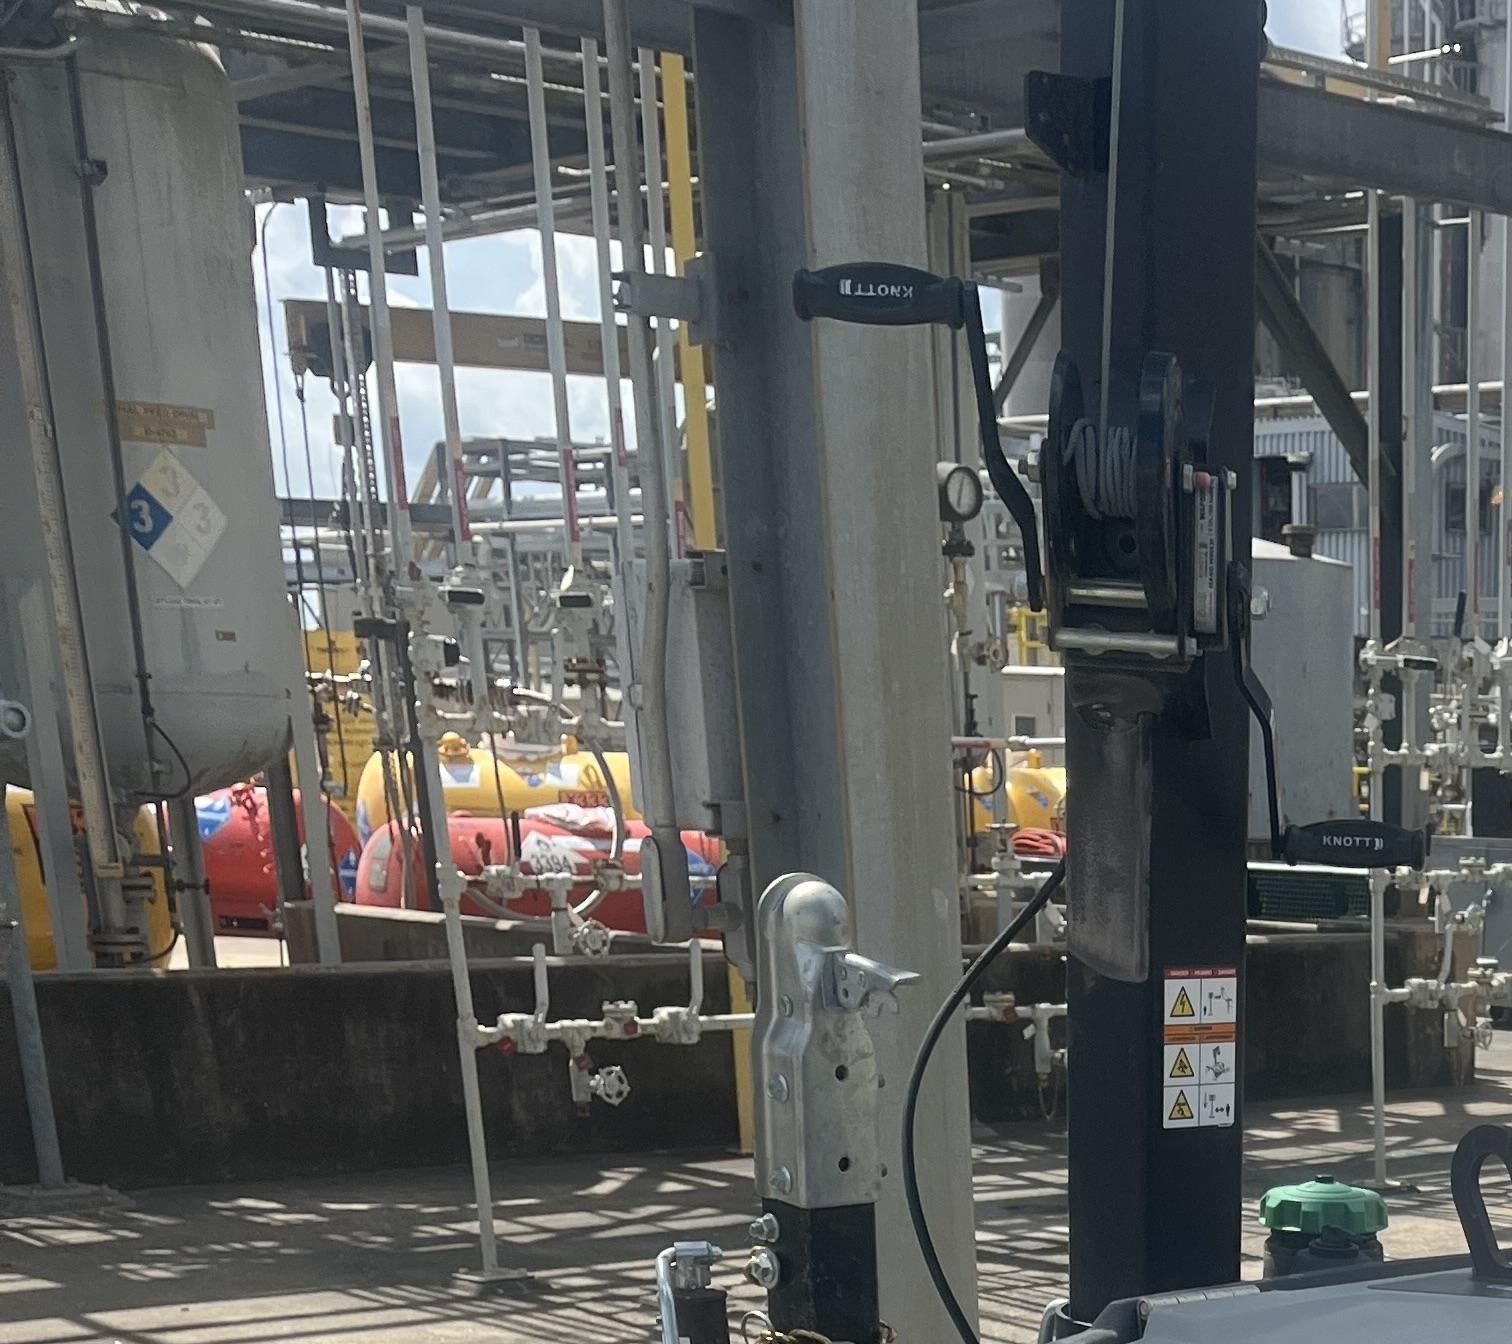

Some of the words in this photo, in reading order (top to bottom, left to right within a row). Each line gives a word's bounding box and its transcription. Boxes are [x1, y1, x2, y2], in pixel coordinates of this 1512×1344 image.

[852, 282, 913, 298] KNOTT
[131, 499, 154, 534] 3
[1322, 835, 1371, 848] KNOTT
[531, 853, 573, 875] 3394
